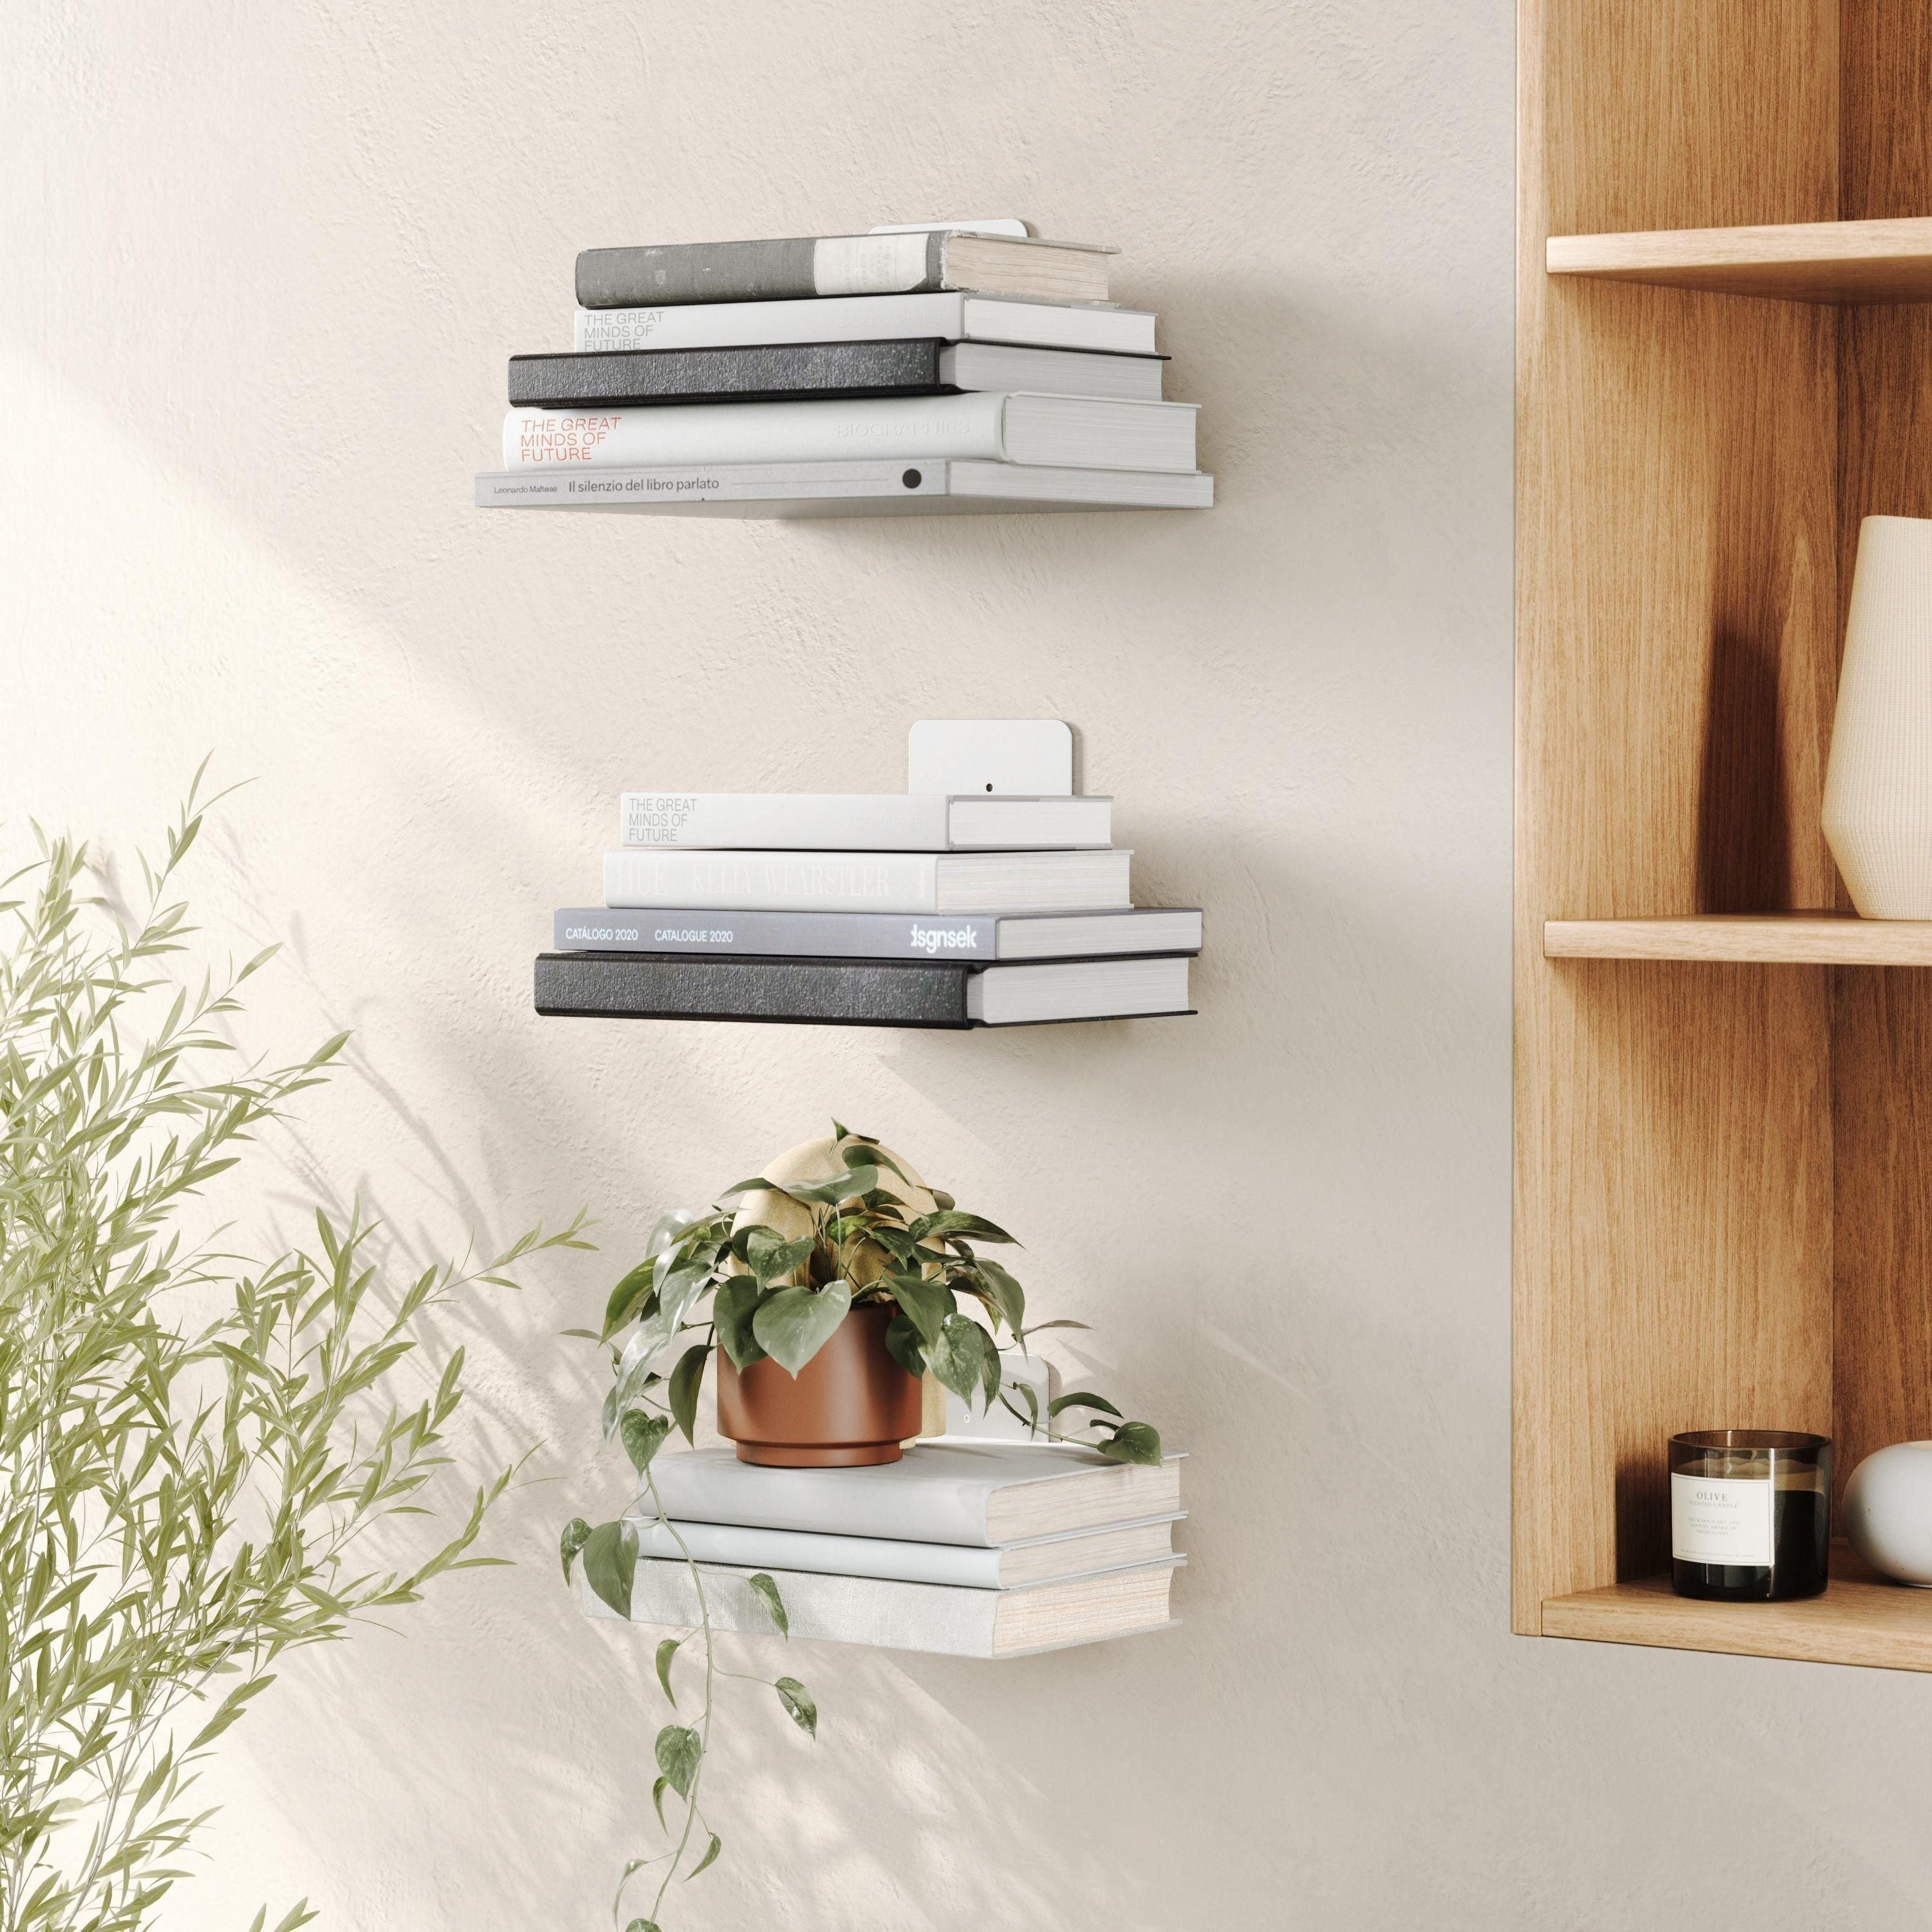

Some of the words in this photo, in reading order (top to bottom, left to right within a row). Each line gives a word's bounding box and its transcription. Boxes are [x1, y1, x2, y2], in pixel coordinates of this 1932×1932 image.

[584, 314, 613, 326] THE
[616, 311, 665, 325] GREAT
[584, 326, 630, 338] MINDS
[634, 325, 654, 336] OF
[584, 339, 641, 351] FUTURE
[522, 419, 556, 432] THE
[561, 417, 621, 431] GREAT
[837, 421, 970, 437] BIOGRAPHIES
[521, 433, 577, 447] MINDS
[583, 432, 607, 446] OF
[522, 447, 592, 462] FUTURE
[569, 480, 575, 492] Il
[578, 480, 623, 493] silenzio
[625, 479, 644, 491] del
[647, 478, 674, 491] libro
[677, 477, 719, 493] parlato
[629, 798, 653, 811] THE
[657, 798, 697, 811] GREAT
[629, 813, 668, 826] MINDS
[672, 813, 688, 827] OF
[629, 828, 677, 842] FUTURE
[692, 863, 753, 895] KELLY
[763, 864, 891, 897] WEARSTLER
[565, 925, 613, 940] CATÁLOGO
[615, 929, 638, 941] 2020
[654, 929, 707, 942] CATALOGUE
[710, 930, 733, 942] 2020
[1696, 1492, 1728, 1501] OLIVE
